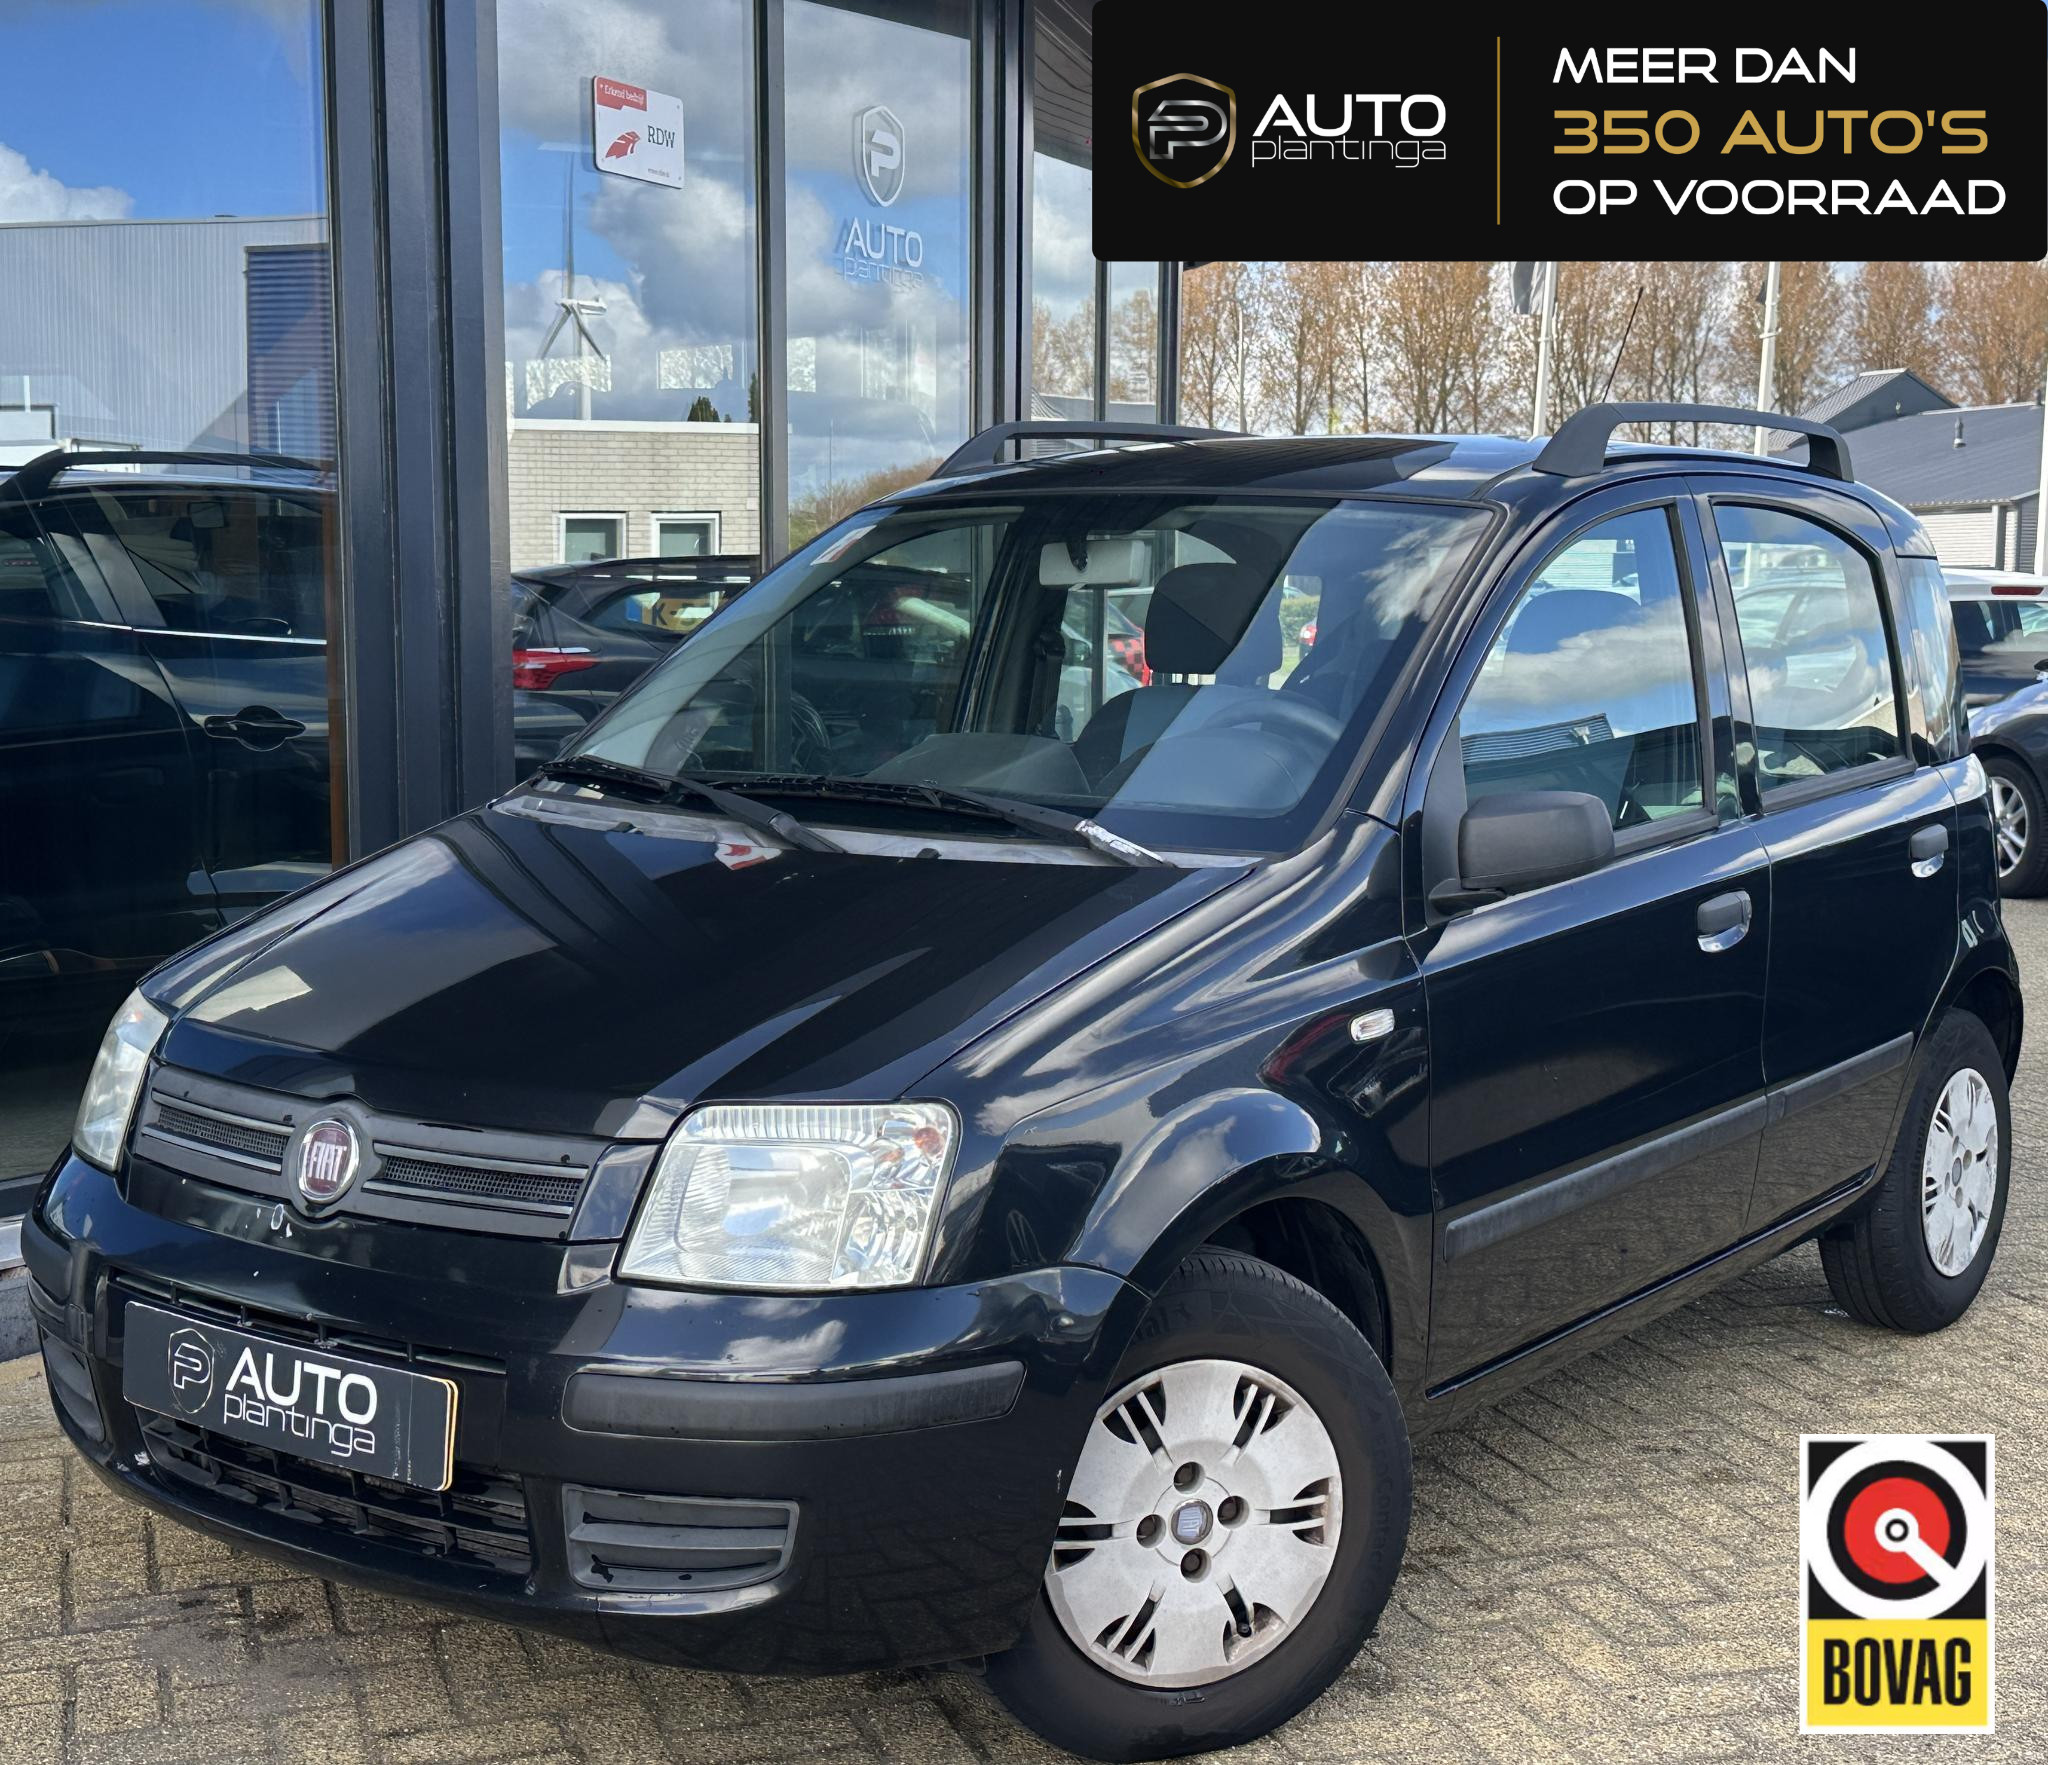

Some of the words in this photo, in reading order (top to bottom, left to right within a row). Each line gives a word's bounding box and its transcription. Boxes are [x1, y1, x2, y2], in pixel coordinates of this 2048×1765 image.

[647, 125, 676, 149] RDW
[845, 217, 924, 268] AUTO
[308, 1141, 348, 1182] FIAT
[225, 1347, 378, 1425] AUTO
[223, 1393, 375, 1457] plantinga
